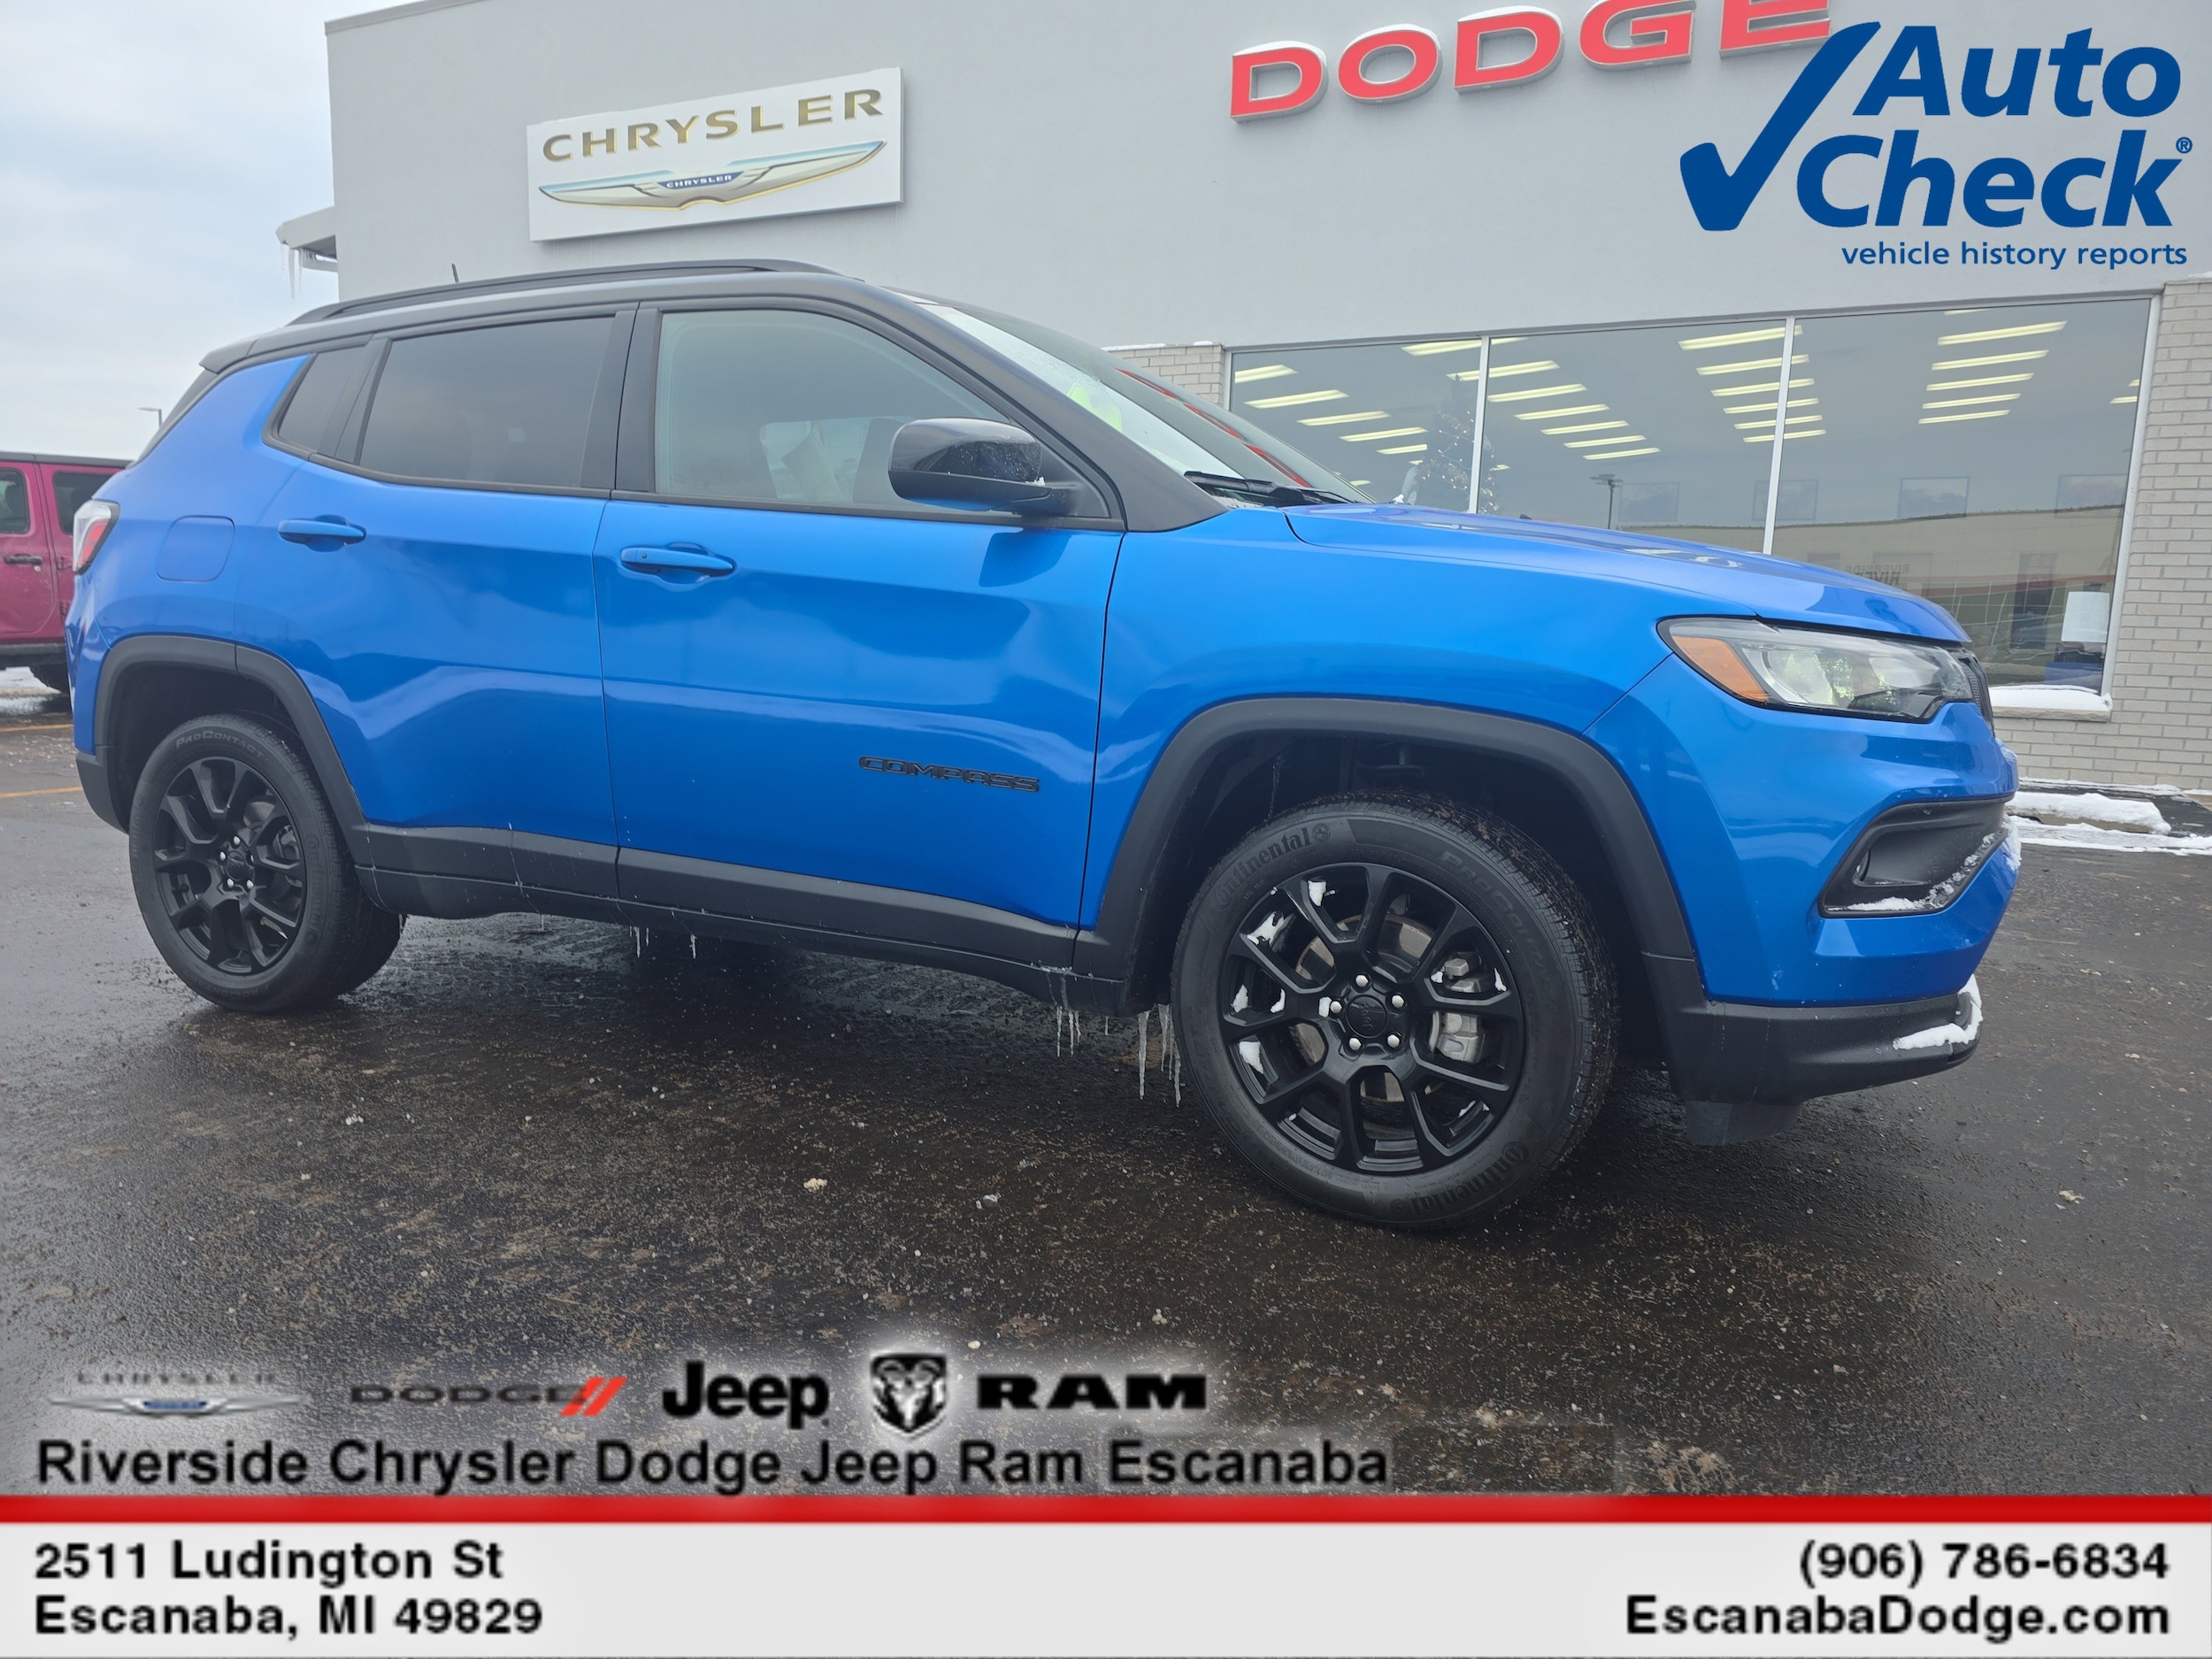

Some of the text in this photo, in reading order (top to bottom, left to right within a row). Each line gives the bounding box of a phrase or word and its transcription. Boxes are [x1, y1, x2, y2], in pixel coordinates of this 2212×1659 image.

[1231, 0, 1833, 122] DODGE
[542, 88, 884, 162] CHRYSLER
[666, 173, 733, 188] CHRYSLER
[858, 756, 1040, 793] COMPASS
[1214, 827, 1312, 911] Continental
